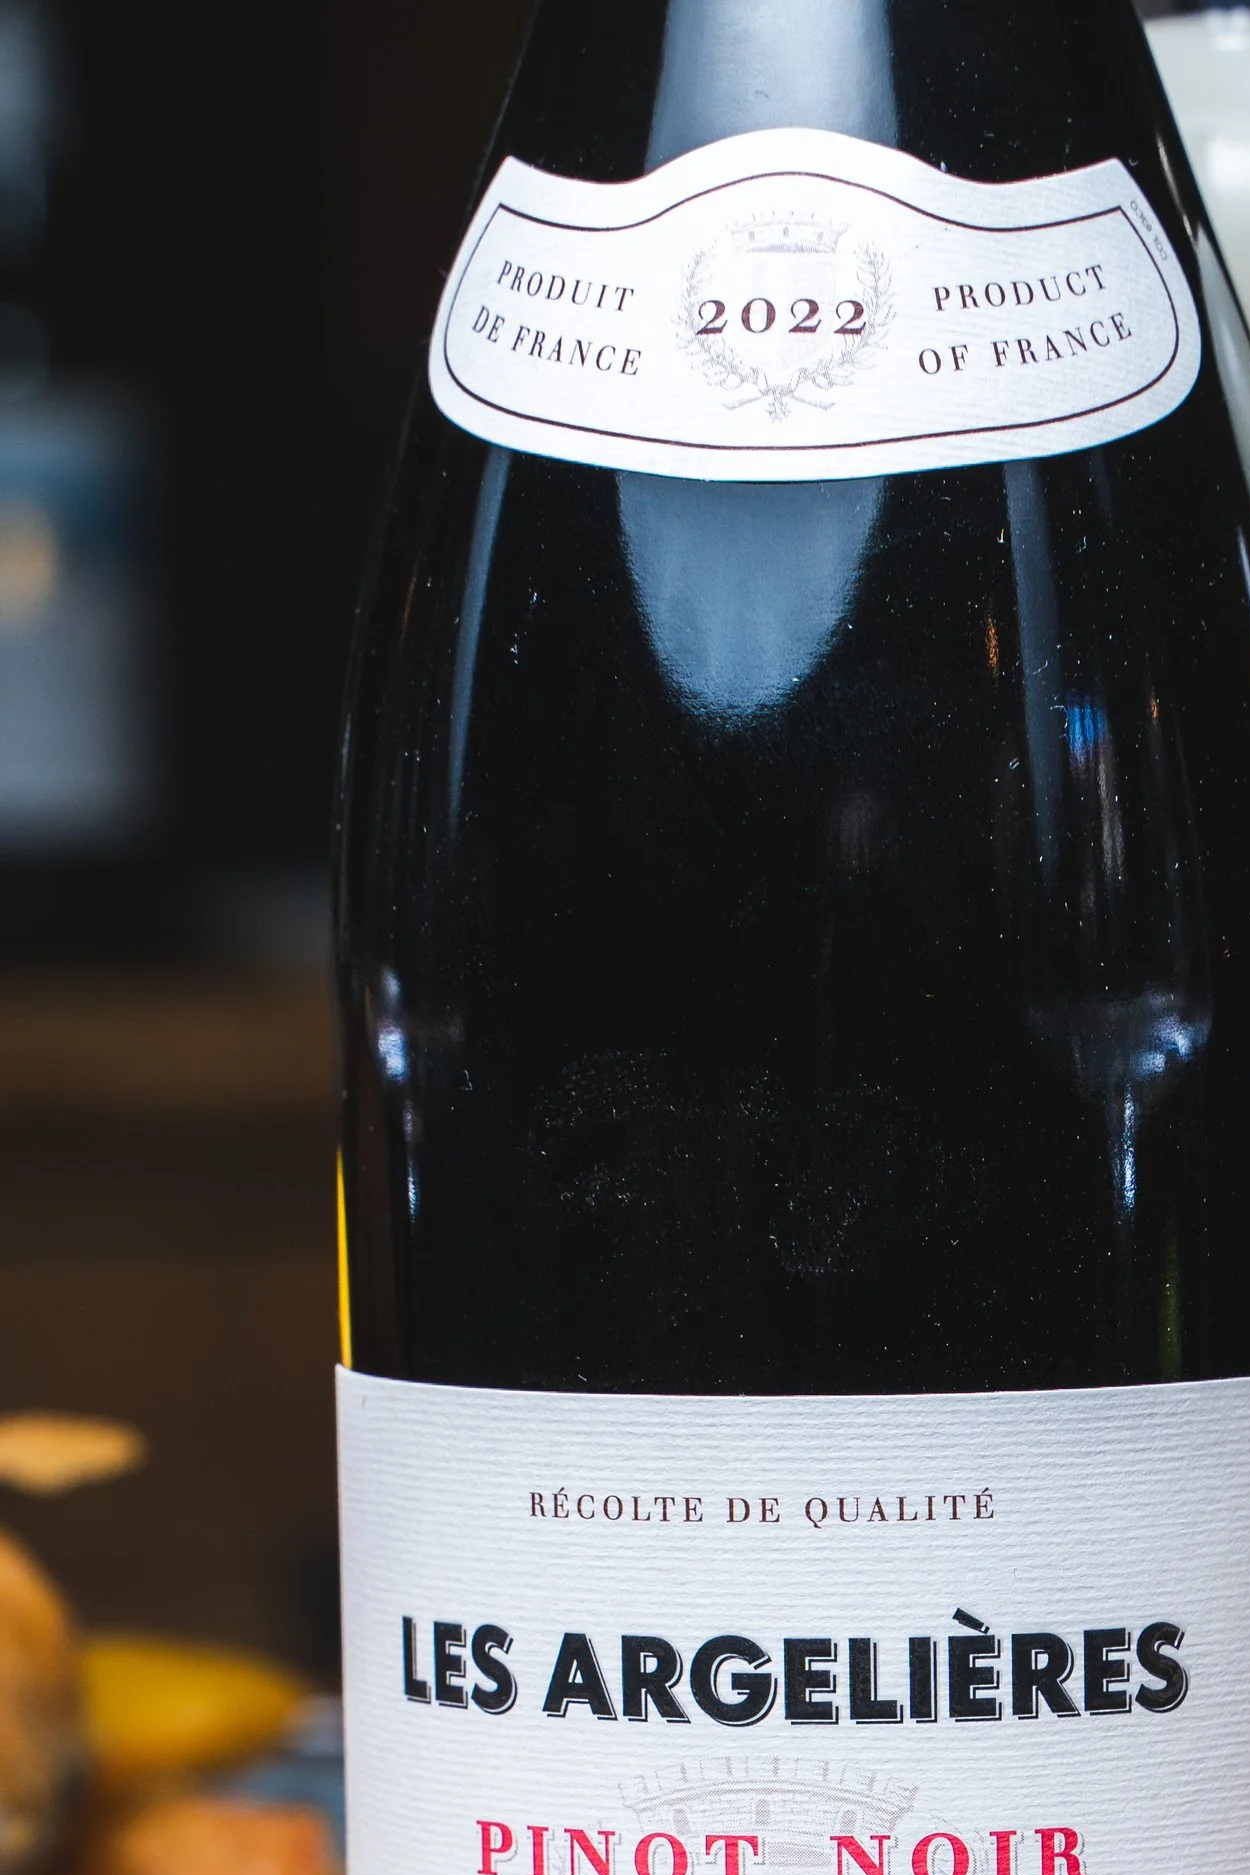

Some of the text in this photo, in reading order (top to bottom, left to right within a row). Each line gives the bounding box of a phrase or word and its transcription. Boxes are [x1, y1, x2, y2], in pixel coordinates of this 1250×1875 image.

[496, 258, 637, 314] PRODUIT
[932, 262, 1108, 313] PRODUCT
[471, 304, 643, 377] DE FRANCE
[695, 295, 869, 338] 2022
[918, 311, 1134, 376] OF FRANCE
[528, 1486, 998, 1530] RÉCOLTE DE QUALITÉ
[401, 1607, 1191, 1728] LES ARGELIÈRES
